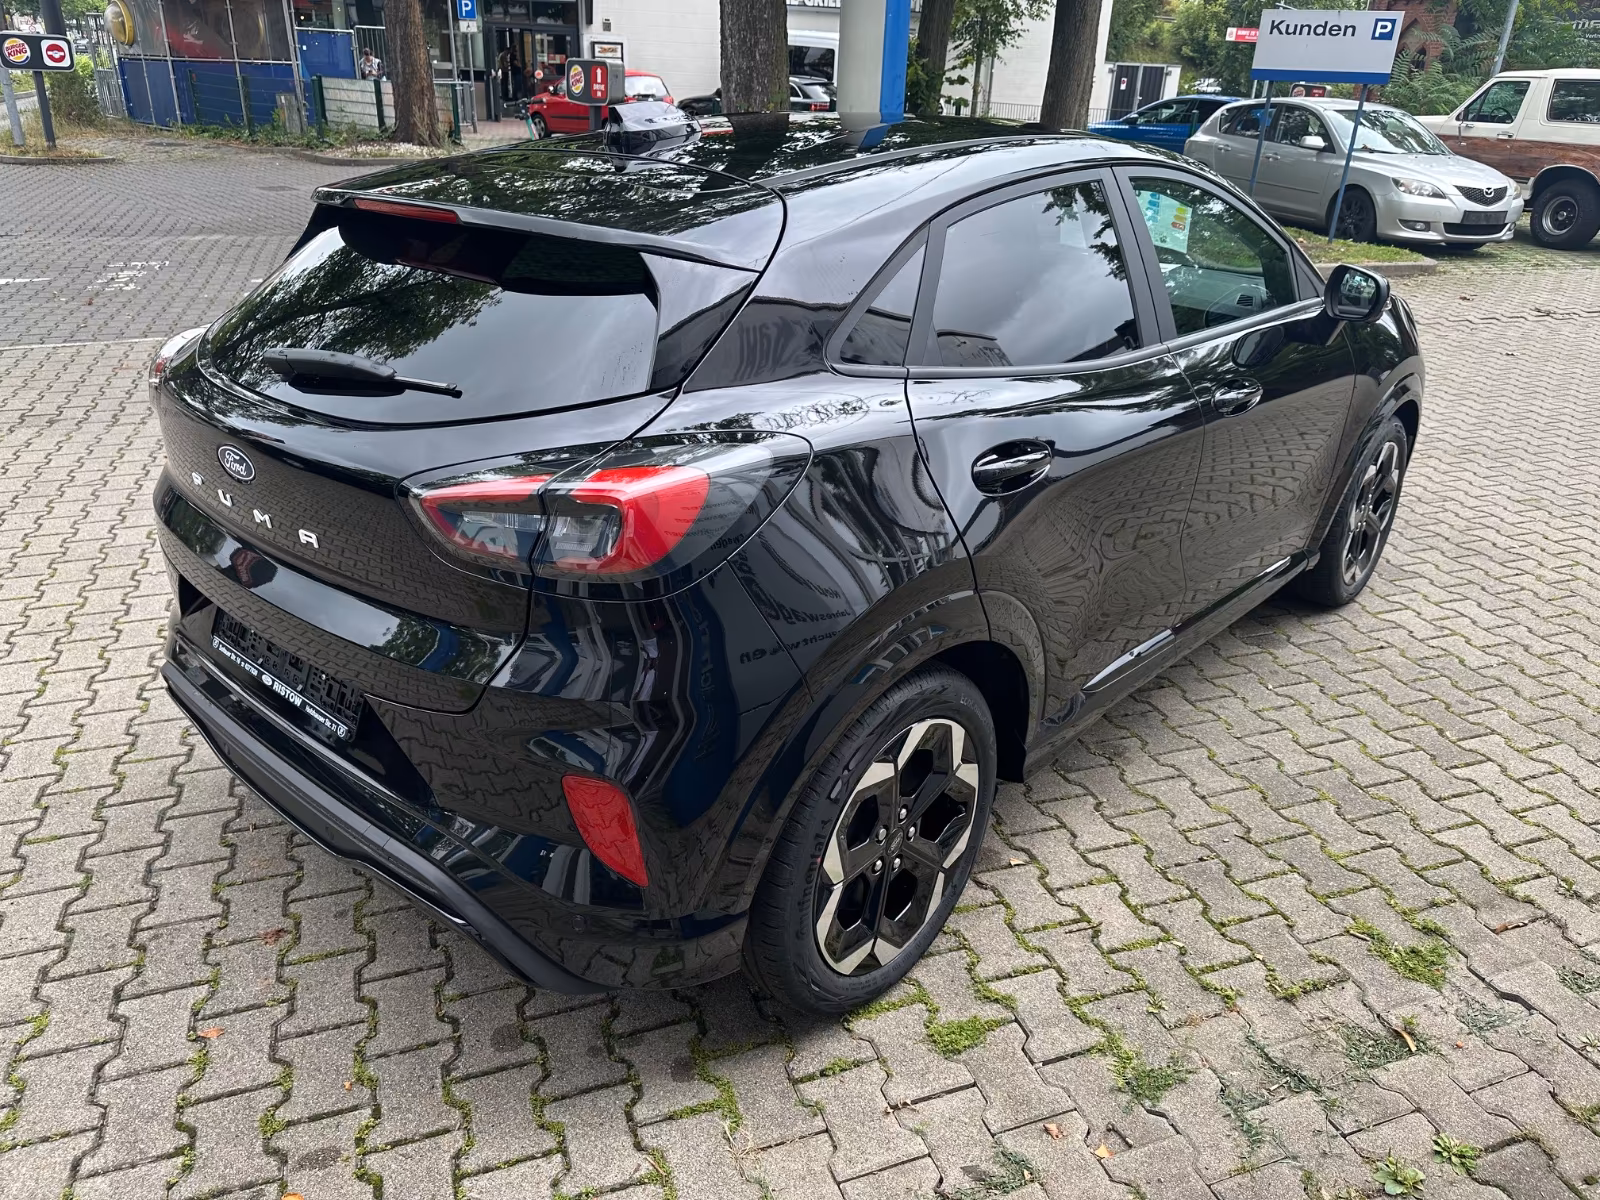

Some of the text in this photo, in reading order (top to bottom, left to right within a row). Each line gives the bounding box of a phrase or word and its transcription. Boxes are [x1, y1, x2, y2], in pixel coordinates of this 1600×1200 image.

[1269, 20, 1393, 38] Kunden P
[5, 43, 26, 51] BURGER
[7, 48, 27, 57] KING
[571, 76, 583, 87] KING
[224, 450, 247, 476] Ford
[272, 681, 303, 707] RISTOW
